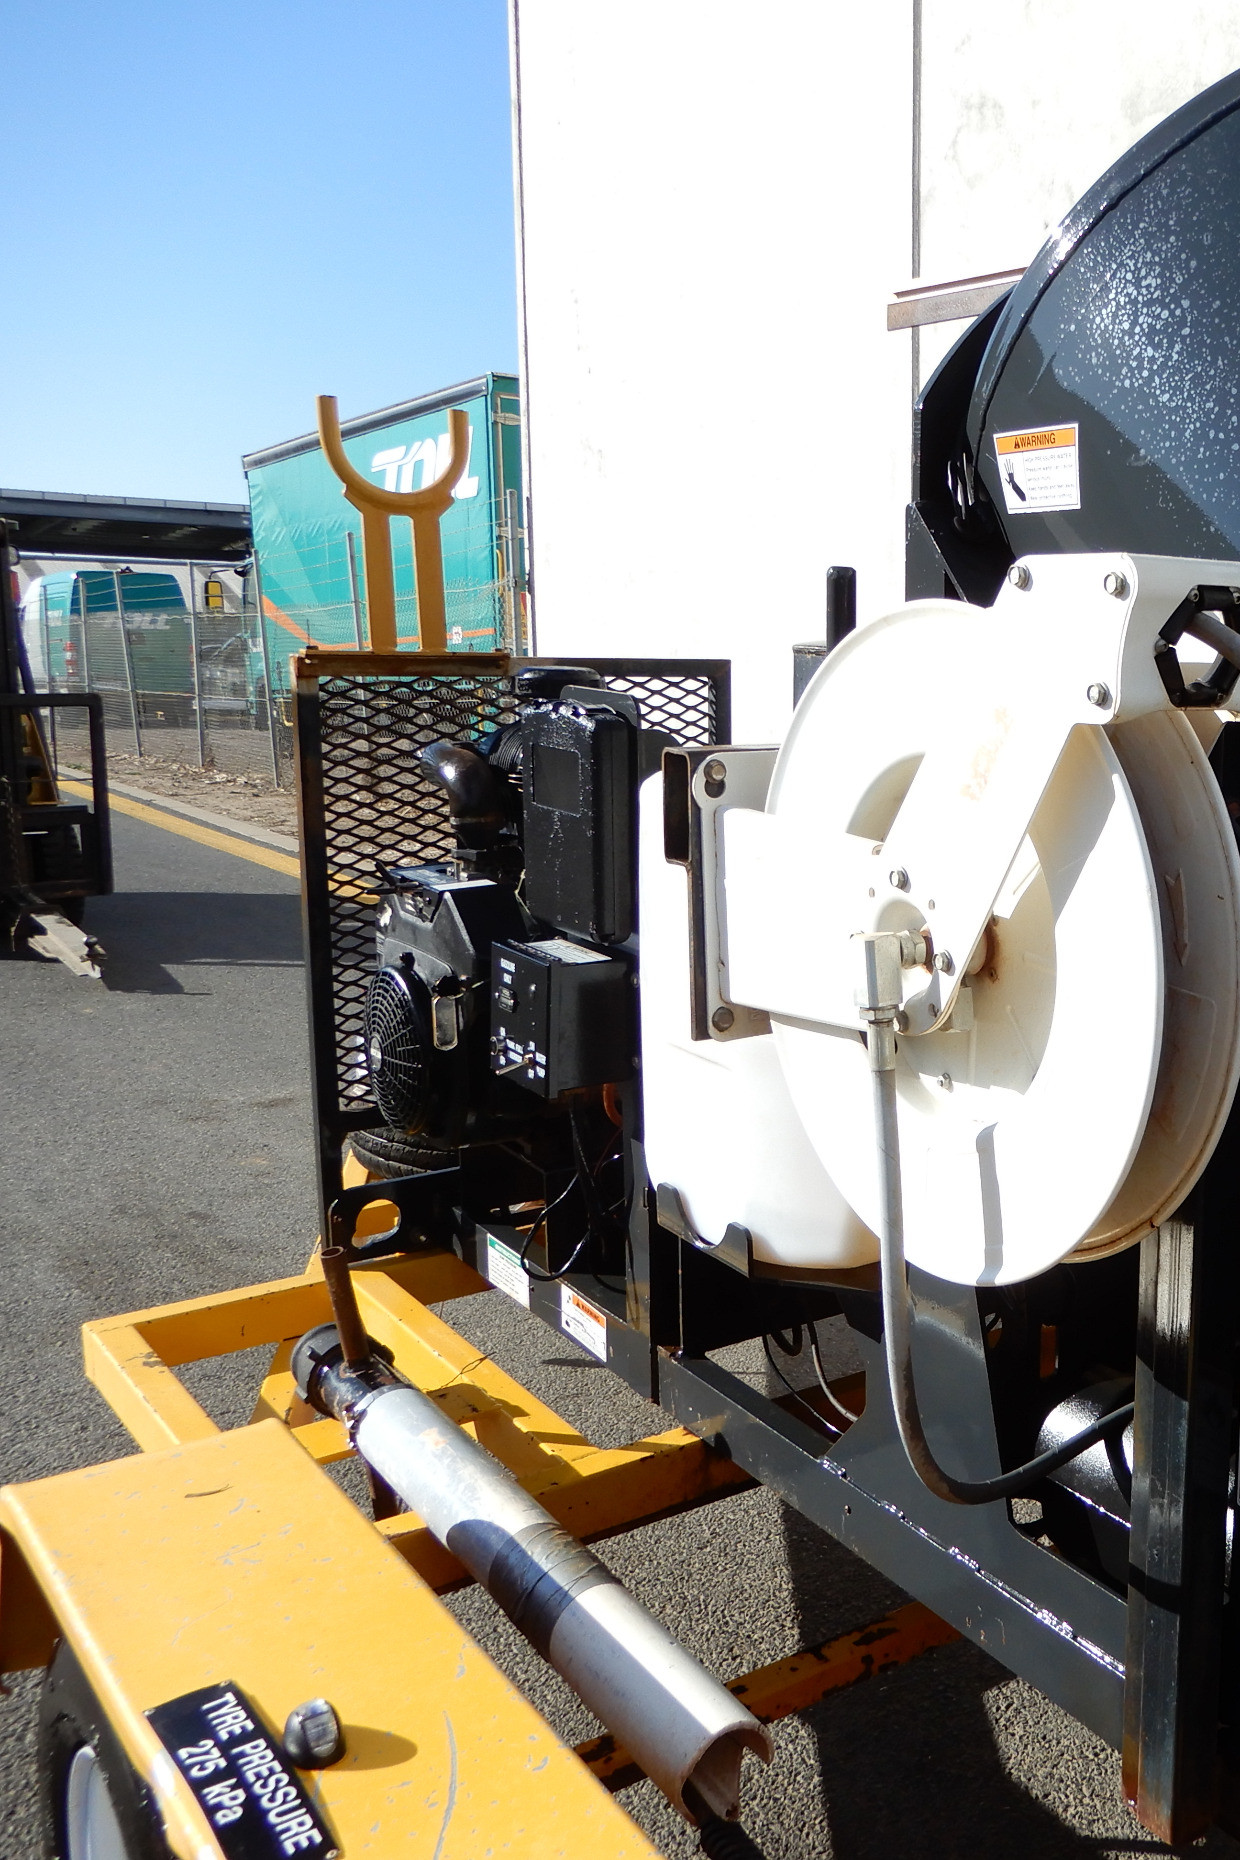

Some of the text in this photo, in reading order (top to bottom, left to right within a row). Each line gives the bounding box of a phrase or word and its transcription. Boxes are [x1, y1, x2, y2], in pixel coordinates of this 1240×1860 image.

[1020, 433, 1056, 448] WARNING
[177, 1739, 247, 1826] 275 kPa
[201, 1691, 324, 1856] TYRE PRESSURE
